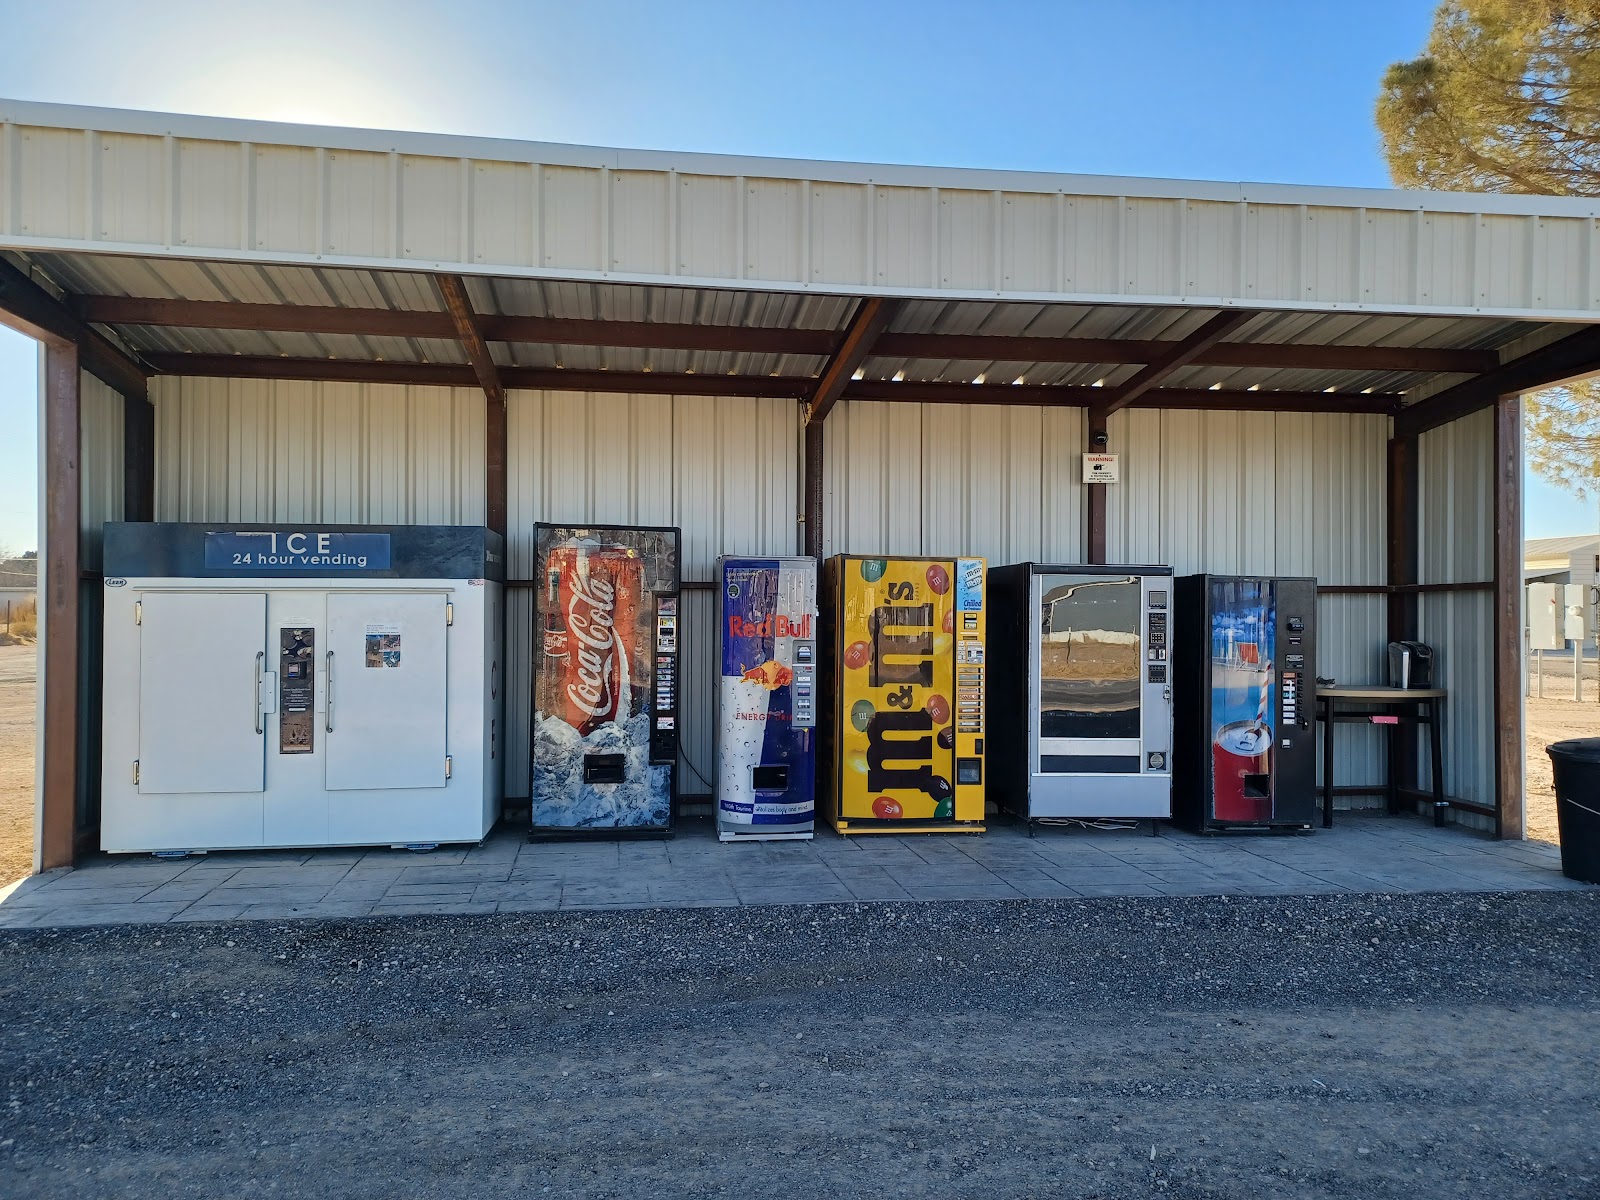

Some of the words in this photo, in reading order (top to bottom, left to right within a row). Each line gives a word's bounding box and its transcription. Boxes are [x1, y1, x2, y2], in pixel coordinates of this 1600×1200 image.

[271, 532, 330, 554] ICE
[233, 553, 251, 565] 24
[258, 553, 295, 565] hour
[301, 554, 367, 567] vending
[729, 613, 772, 638] Red
[776, 613, 811, 638] Bull
[567, 570, 614, 716] Coca-Cola
[736, 712, 771, 721] ENERGY
